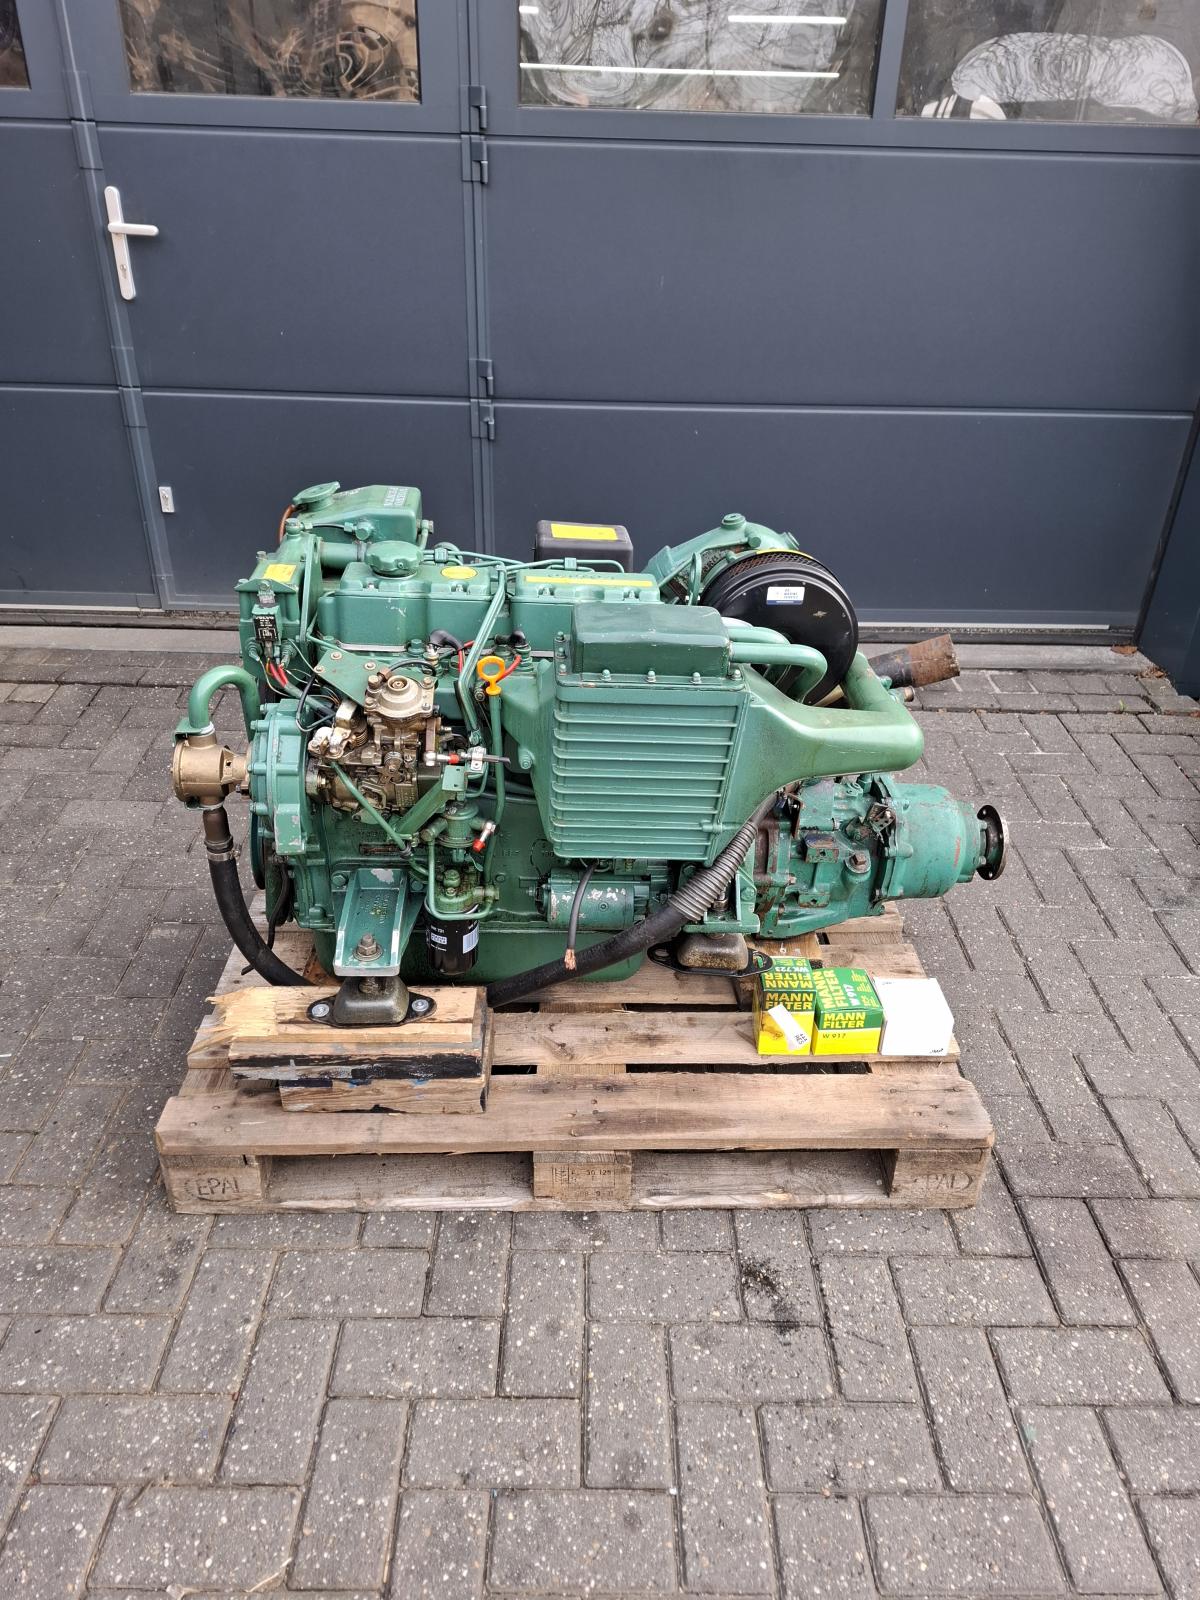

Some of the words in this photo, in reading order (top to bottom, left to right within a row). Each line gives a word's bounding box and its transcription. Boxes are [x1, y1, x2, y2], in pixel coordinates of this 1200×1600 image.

[764, 972, 811, 981] FILTER
[764, 980, 812, 989] MANN
[812, 970, 834, 1009] MANN
[823, 969, 848, 1008] FILTER
[765, 992, 813, 1002] MANN
[823, 1011, 866, 1021] MANN
[822, 1020, 865, 1029] FILTER
